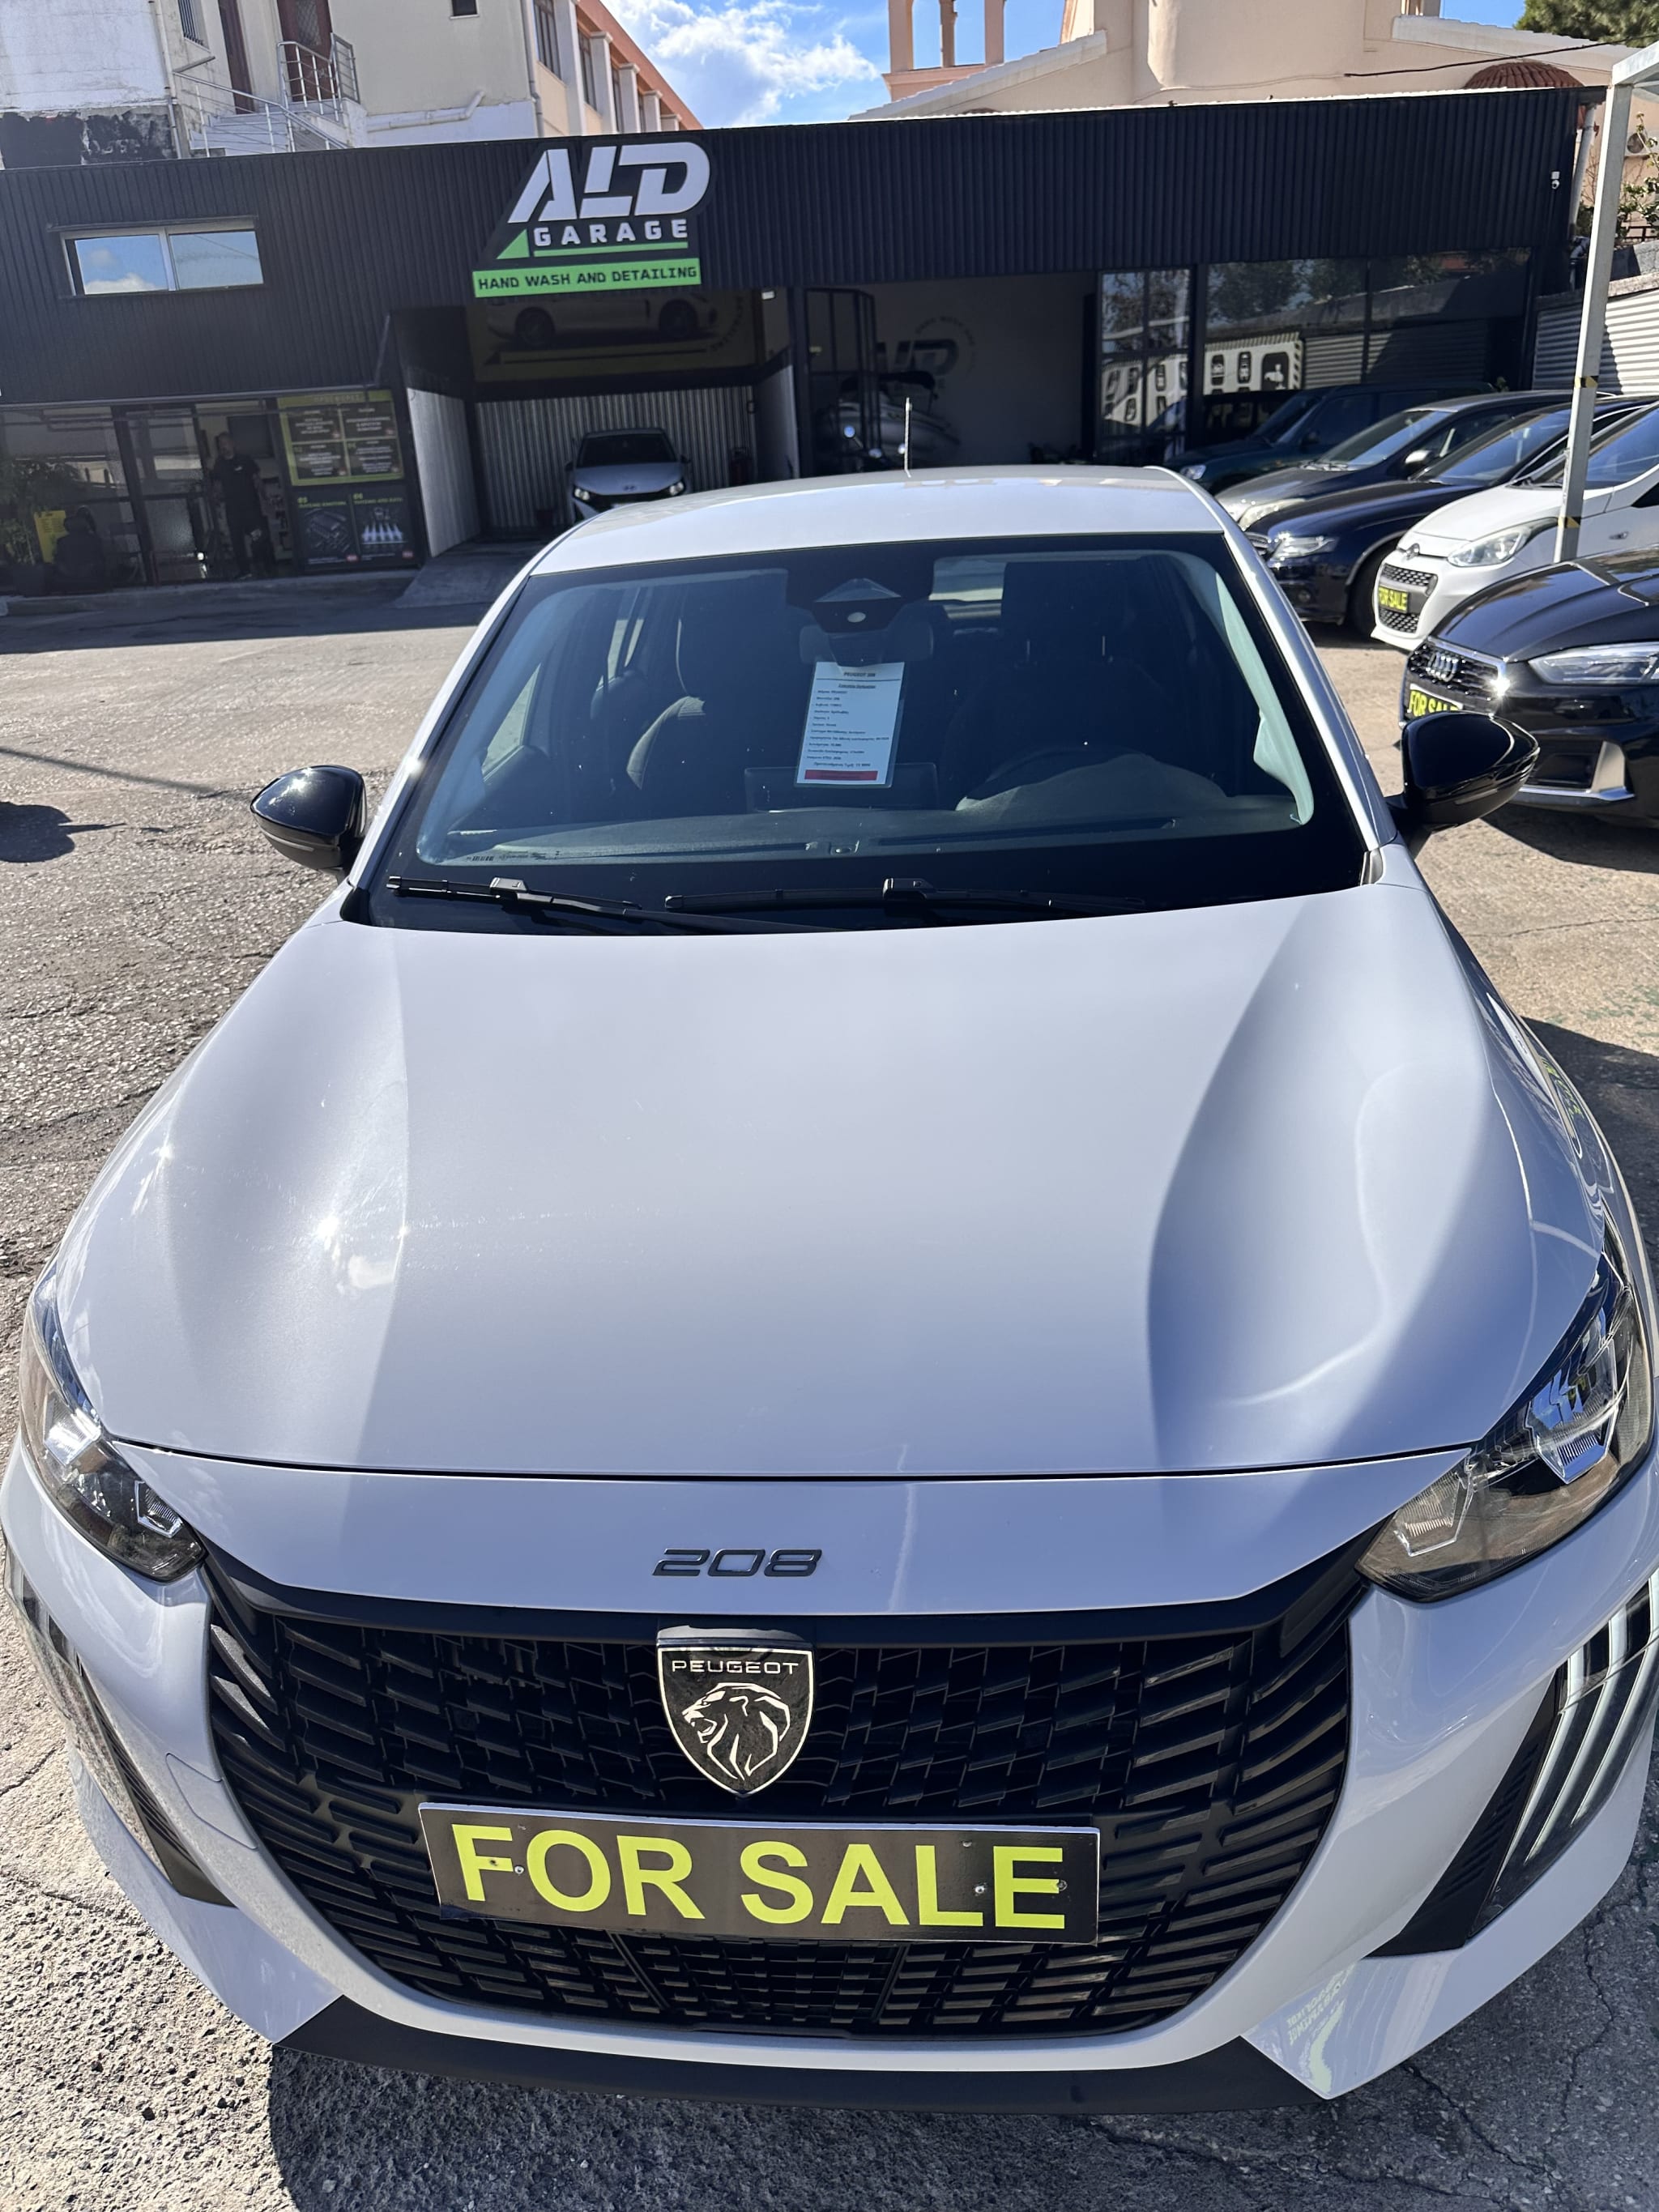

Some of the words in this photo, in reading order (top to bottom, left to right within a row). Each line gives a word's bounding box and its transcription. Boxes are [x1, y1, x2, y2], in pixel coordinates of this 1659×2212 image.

[507, 142, 710, 224] ALD
[533, 219, 689, 247] GARAGE
[478, 276, 520, 290] HAND
[525, 273, 570, 287] WASH
[578, 271, 606, 283] AND
[612, 266, 697, 282] DETAILING
[1409, 690, 1427, 717] FOR
[652, 1549, 822, 1577] 208
[672, 1660, 799, 1675] PEUGEOT
[451, 1823, 706, 1920] FOR
[740, 1841, 1065, 1929] SALE
